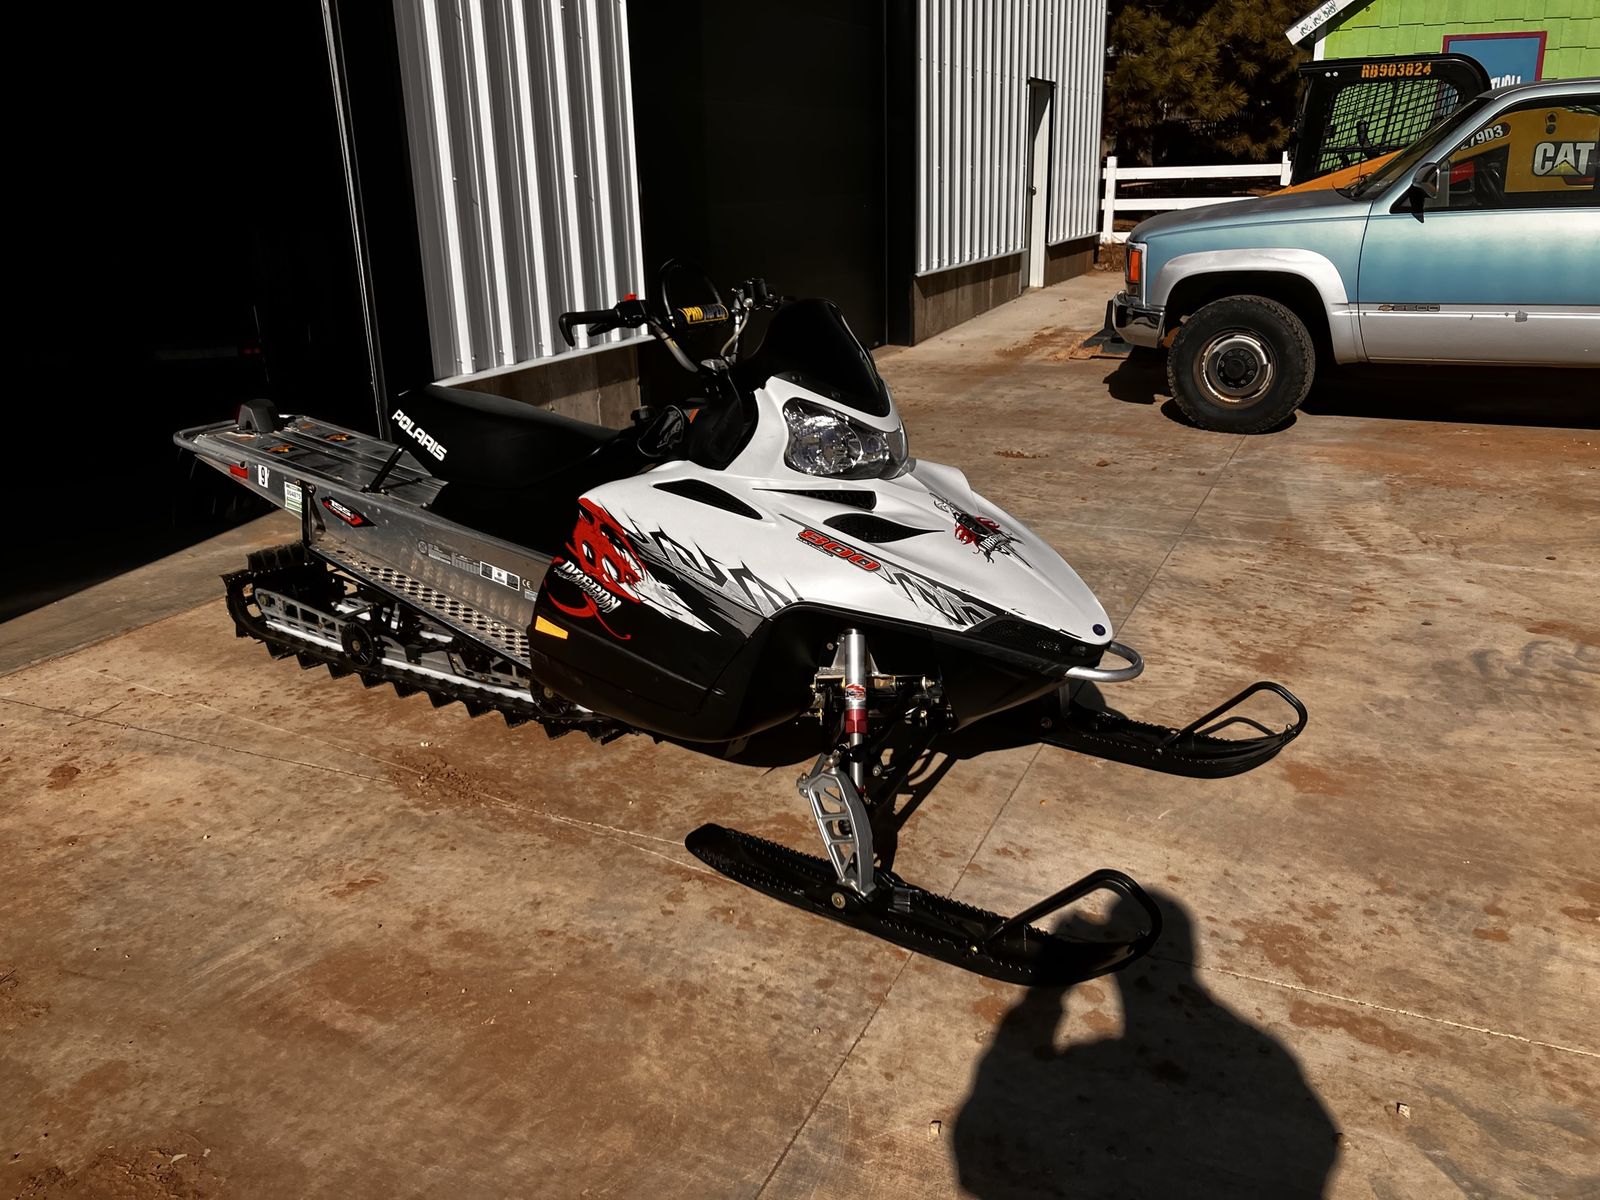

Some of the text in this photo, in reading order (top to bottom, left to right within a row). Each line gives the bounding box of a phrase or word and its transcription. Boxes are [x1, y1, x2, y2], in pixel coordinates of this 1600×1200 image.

[1533, 142, 1596, 176] CAT
[682, 306, 704, 322] PRO
[391, 409, 448, 461] POLARIS
[797, 529, 881, 572] 800
